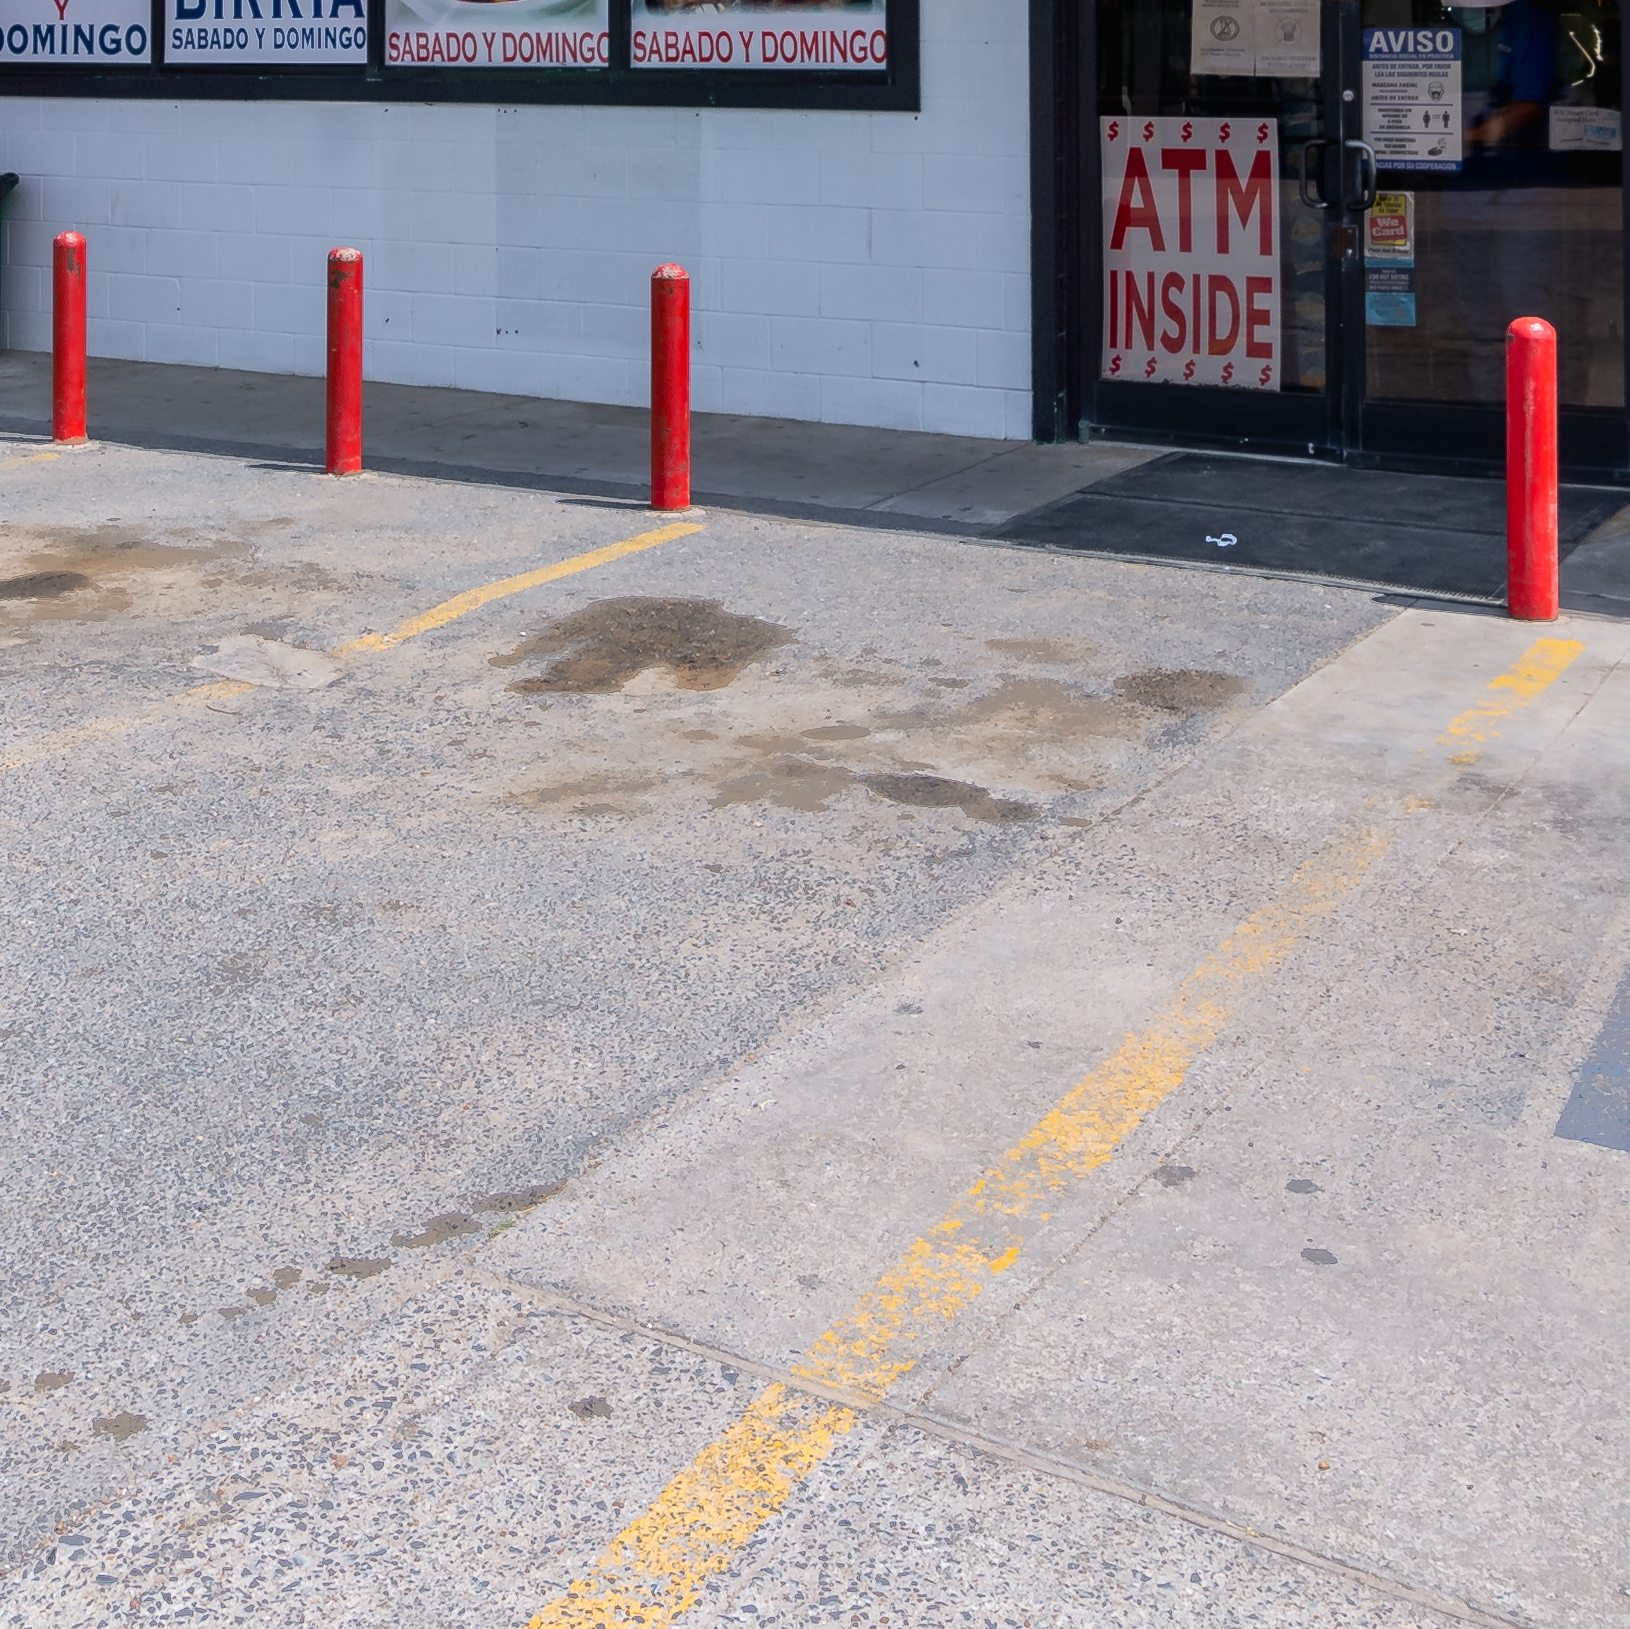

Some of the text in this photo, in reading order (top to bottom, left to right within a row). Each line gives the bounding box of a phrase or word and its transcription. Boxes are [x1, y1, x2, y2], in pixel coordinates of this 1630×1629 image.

[53, 0, 69, 20] Y
[171, 26, 367, 51] SABADO Y DOMINGO
[388, 31, 609, 64] SABADO Y DOMINGO
[632, 29, 887, 64] SABADO Y DOMINGO
[1369, 30, 1454, 53] AVISO
[1110, 146, 1273, 256] ATM
[1372, 226, 1405, 237] Card
[1376, 217, 1399, 227] We
[1109, 269, 1273, 359] INSIDE
